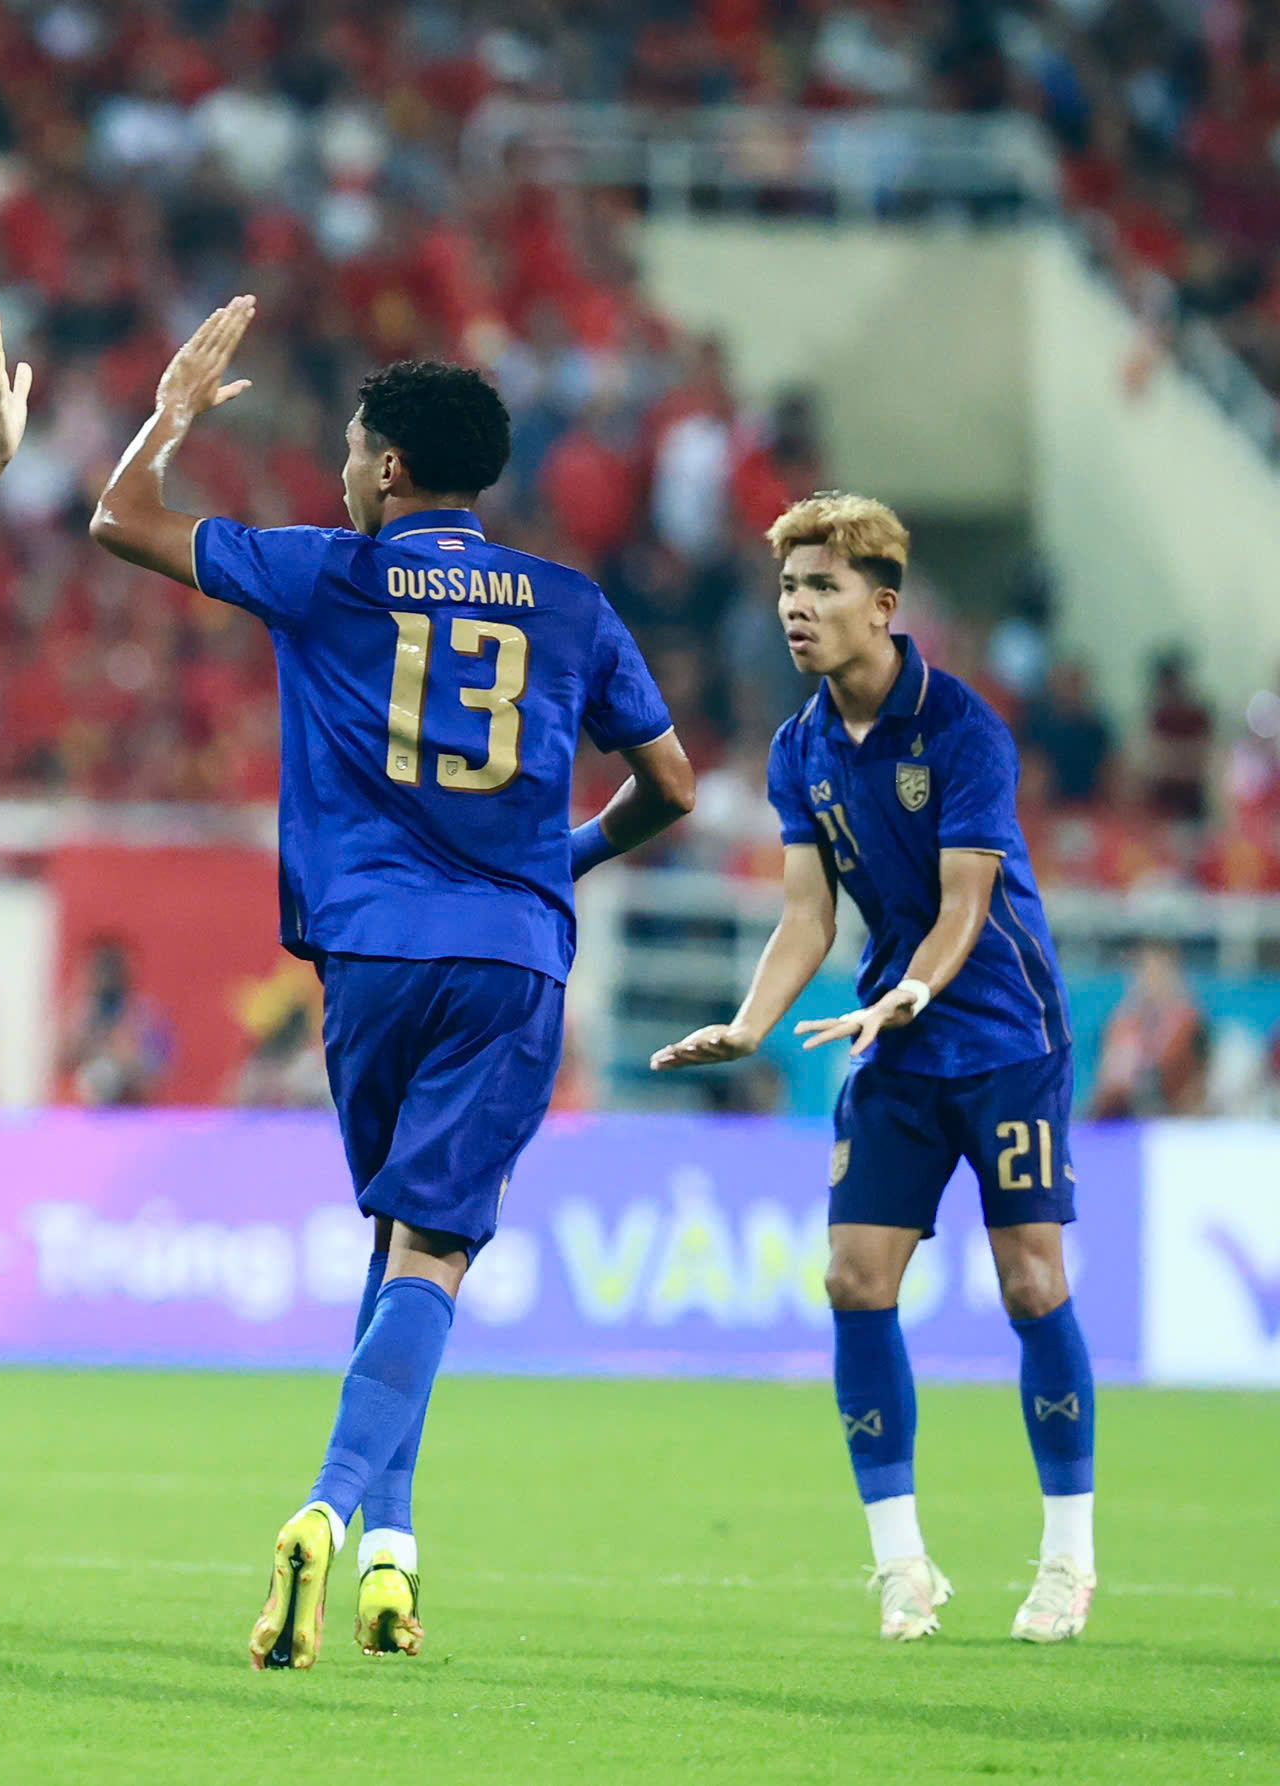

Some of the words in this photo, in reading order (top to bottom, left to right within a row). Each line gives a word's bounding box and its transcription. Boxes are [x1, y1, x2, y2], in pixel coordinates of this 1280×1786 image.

[387, 566, 535, 607] OUSSAMA
[386, 611, 529, 793] 13
[815, 803, 860, 873] 21
[995, 1118, 1054, 1191] 21
